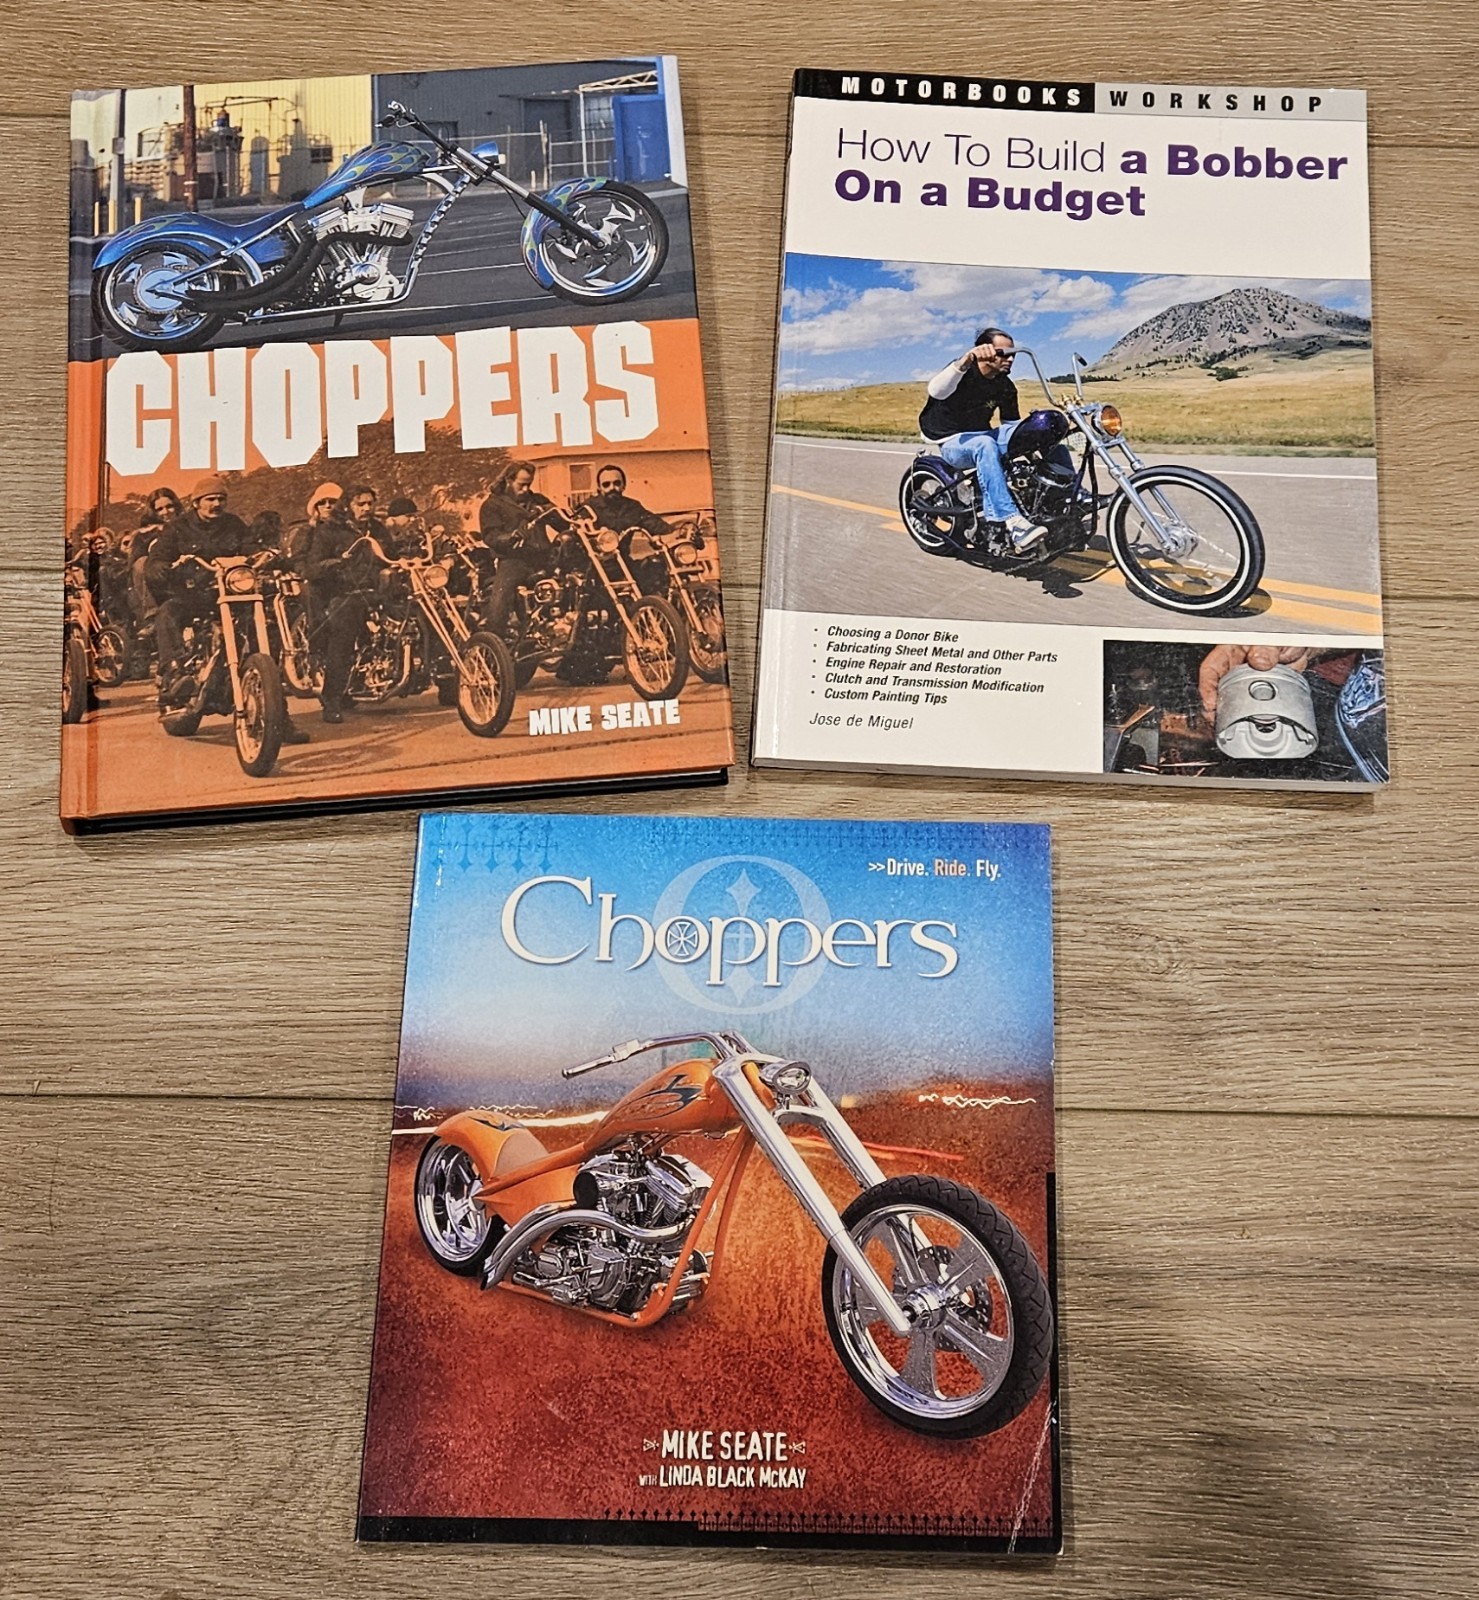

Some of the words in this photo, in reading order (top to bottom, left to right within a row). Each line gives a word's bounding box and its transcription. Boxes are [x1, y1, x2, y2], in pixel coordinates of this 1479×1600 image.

[841, 75, 1082, 107] MOTORBOOKS
[1109, 89, 1323, 114] WORKSHOP
[837, 127, 931, 166] How
[943, 132, 991, 167] To
[1006, 136, 1104, 173] Build
[1119, 147, 1148, 176] a
[1166, 143, 1348, 181] Bobber
[833, 169, 902, 204] On
[920, 180, 948, 207] a
[966, 176, 1146, 221] Budget
[106, 320, 660, 477] CHOPPERS
[827, 625, 881, 641] Choosing
[884, 630, 891, 640] a
[895, 629, 930, 642] Donor
[933, 631, 959, 643] Bike
[826, 641, 892, 657] Fabricating
[895, 644, 928, 657] Sheet
[931, 646, 964, 659] Metal
[967, 648, 989, 660] and
[992, 649, 1024, 662] Other
[1027, 651, 1058, 663] Parts
[825, 657, 865, 672] Engine
[869, 659, 905, 674] Repair
[909, 660, 932, 673] and
[935, 662, 1002, 676] Restoration
[825, 672, 863, 685] Clutch
[866, 674, 888, 686] and
[892, 675, 968, 690] Transmission
[972, 679, 1044, 693] Modification
[824, 687, 868, 701] Custom
[872, 689, 920, 705] Painting
[924, 692, 948, 706] Tips
[528, 705, 593, 736] MIKE
[601, 698, 681, 731] SEATE
[809, 712, 841, 726] Jose
[846, 714, 862, 727] de
[867, 715, 914, 731] Miguel
[934, 859, 970, 877] Ride.
[976, 859, 1001, 881] Fly.
[501, 875, 959, 987] Choppers
[661, 1429, 714, 1460] MIKE
[719, 1430, 788, 1461] SEATE
[659, 1465, 703, 1487] LINDA
[706, 1465, 755, 1488] BLACK
[759, 1466, 807, 1488] McKAY
